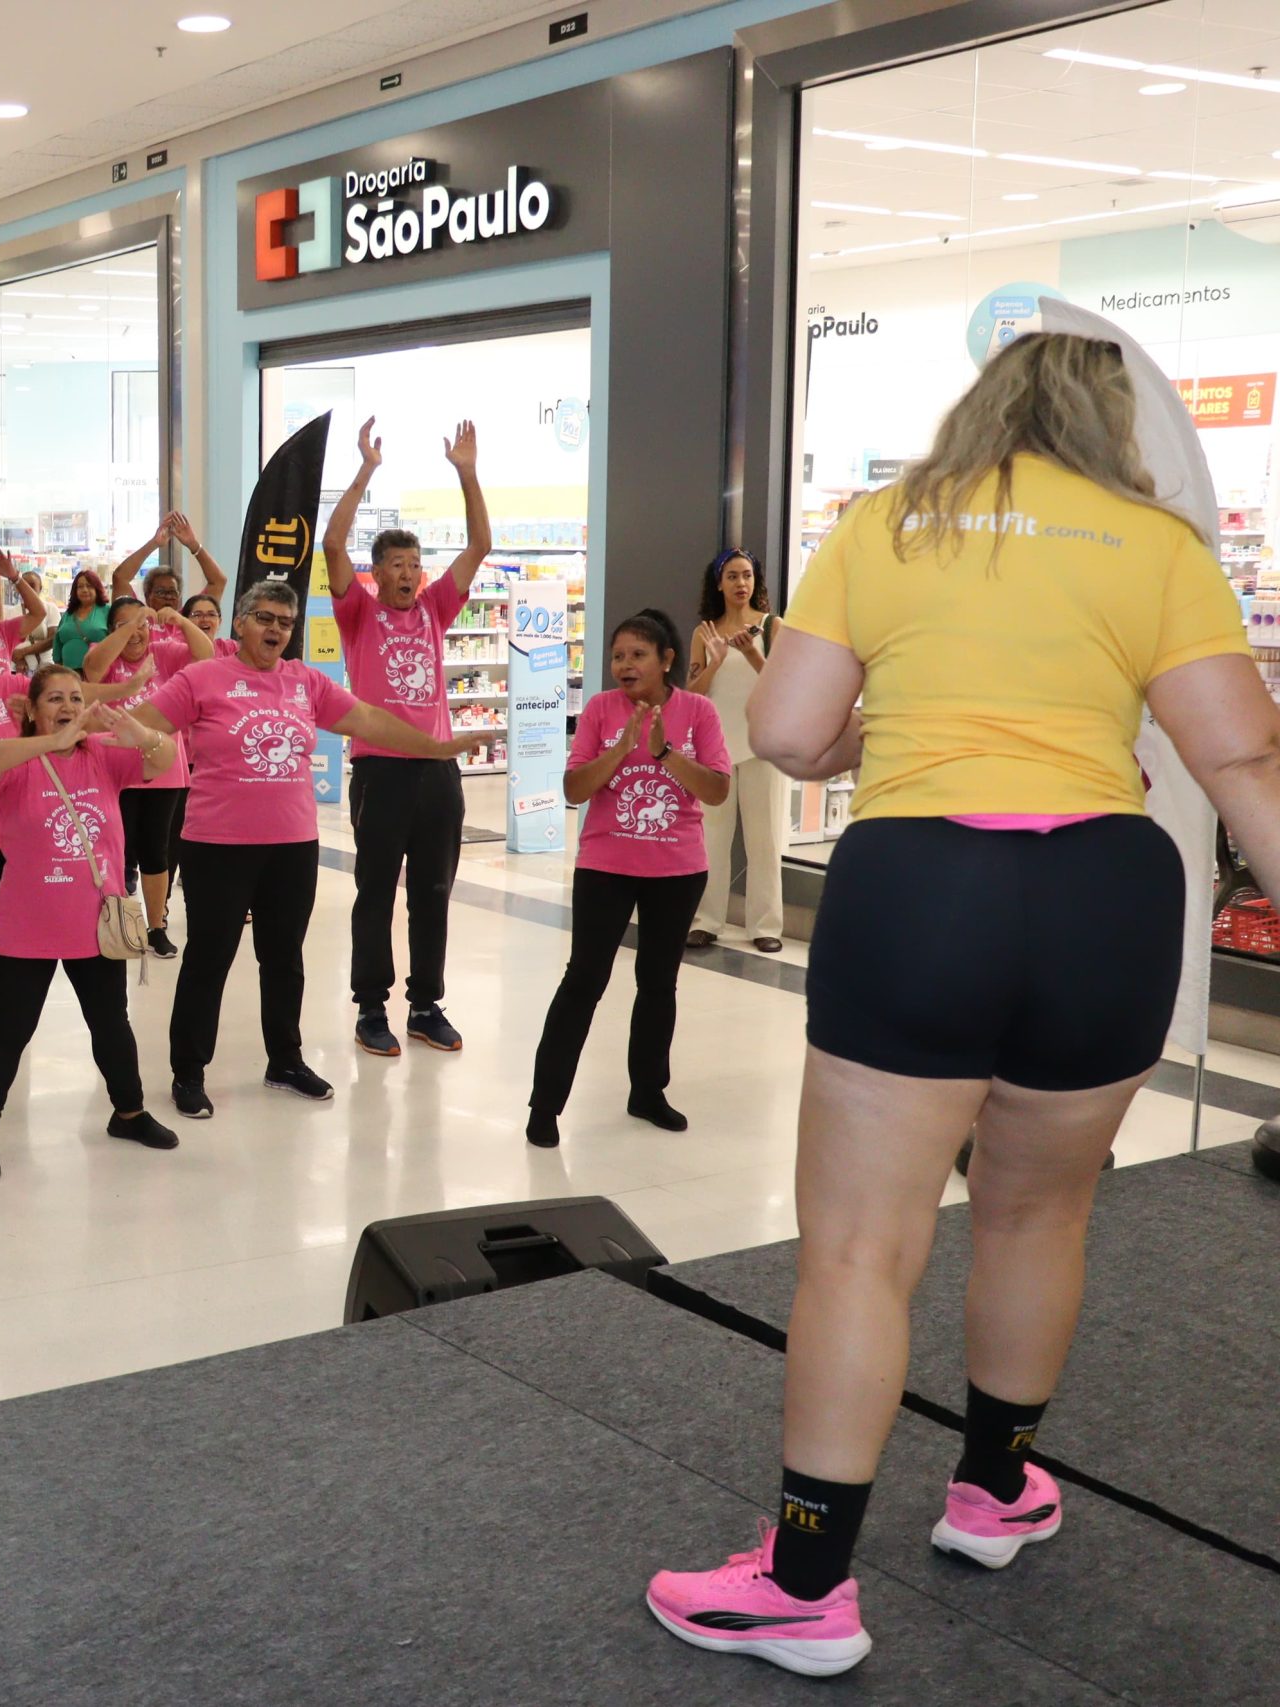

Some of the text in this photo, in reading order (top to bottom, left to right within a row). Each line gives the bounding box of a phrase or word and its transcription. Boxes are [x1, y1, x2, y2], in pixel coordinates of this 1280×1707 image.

[560, 21, 576, 34] D22
[346, 157, 426, 199] Drogaria
[1101, 286, 1231, 311] Medicamentos
[809, 312, 878, 339] oPaulo
[256, 517, 298, 566] fit
[387, 636, 412, 645] Gong
[516, 699, 559, 711] antecipa!
[228, 715, 249, 735] Lian
[249, 708, 280, 718] Gong
[622, 764, 656, 777] Gong
[42, 790, 58, 798] Lian
[44, 817, 53, 828] 25
[783, 1491, 830, 1514] smart
